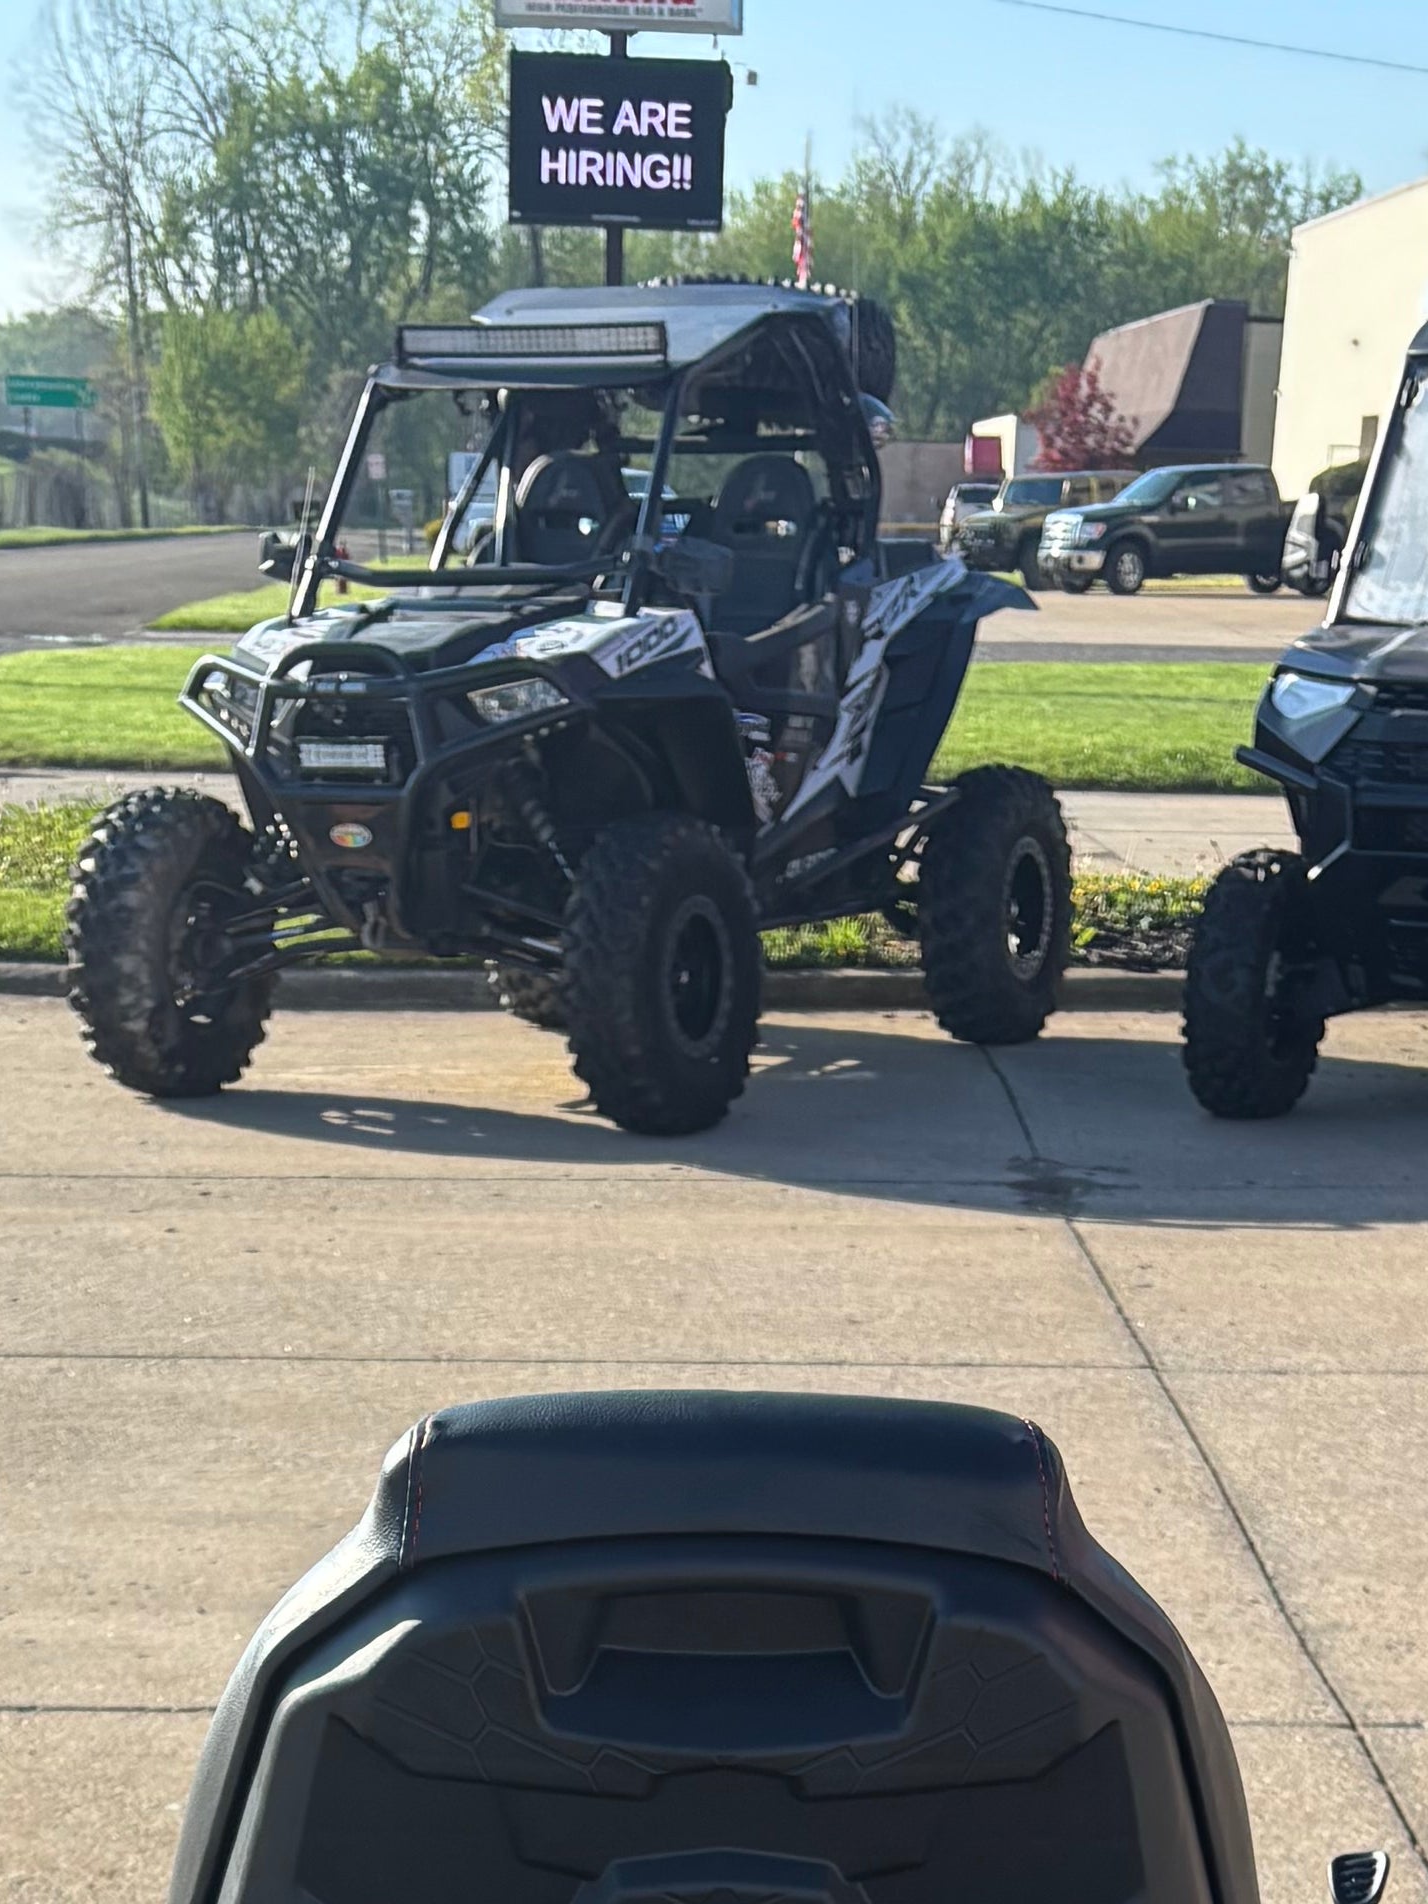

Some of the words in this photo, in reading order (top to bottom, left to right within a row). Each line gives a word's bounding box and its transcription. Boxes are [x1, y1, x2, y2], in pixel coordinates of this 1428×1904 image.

[541, 95, 605, 135] WE
[612, 100, 693, 138] ARE
[540, 146, 692, 191] HIRING!!
[616, 616, 679, 674] 1000
